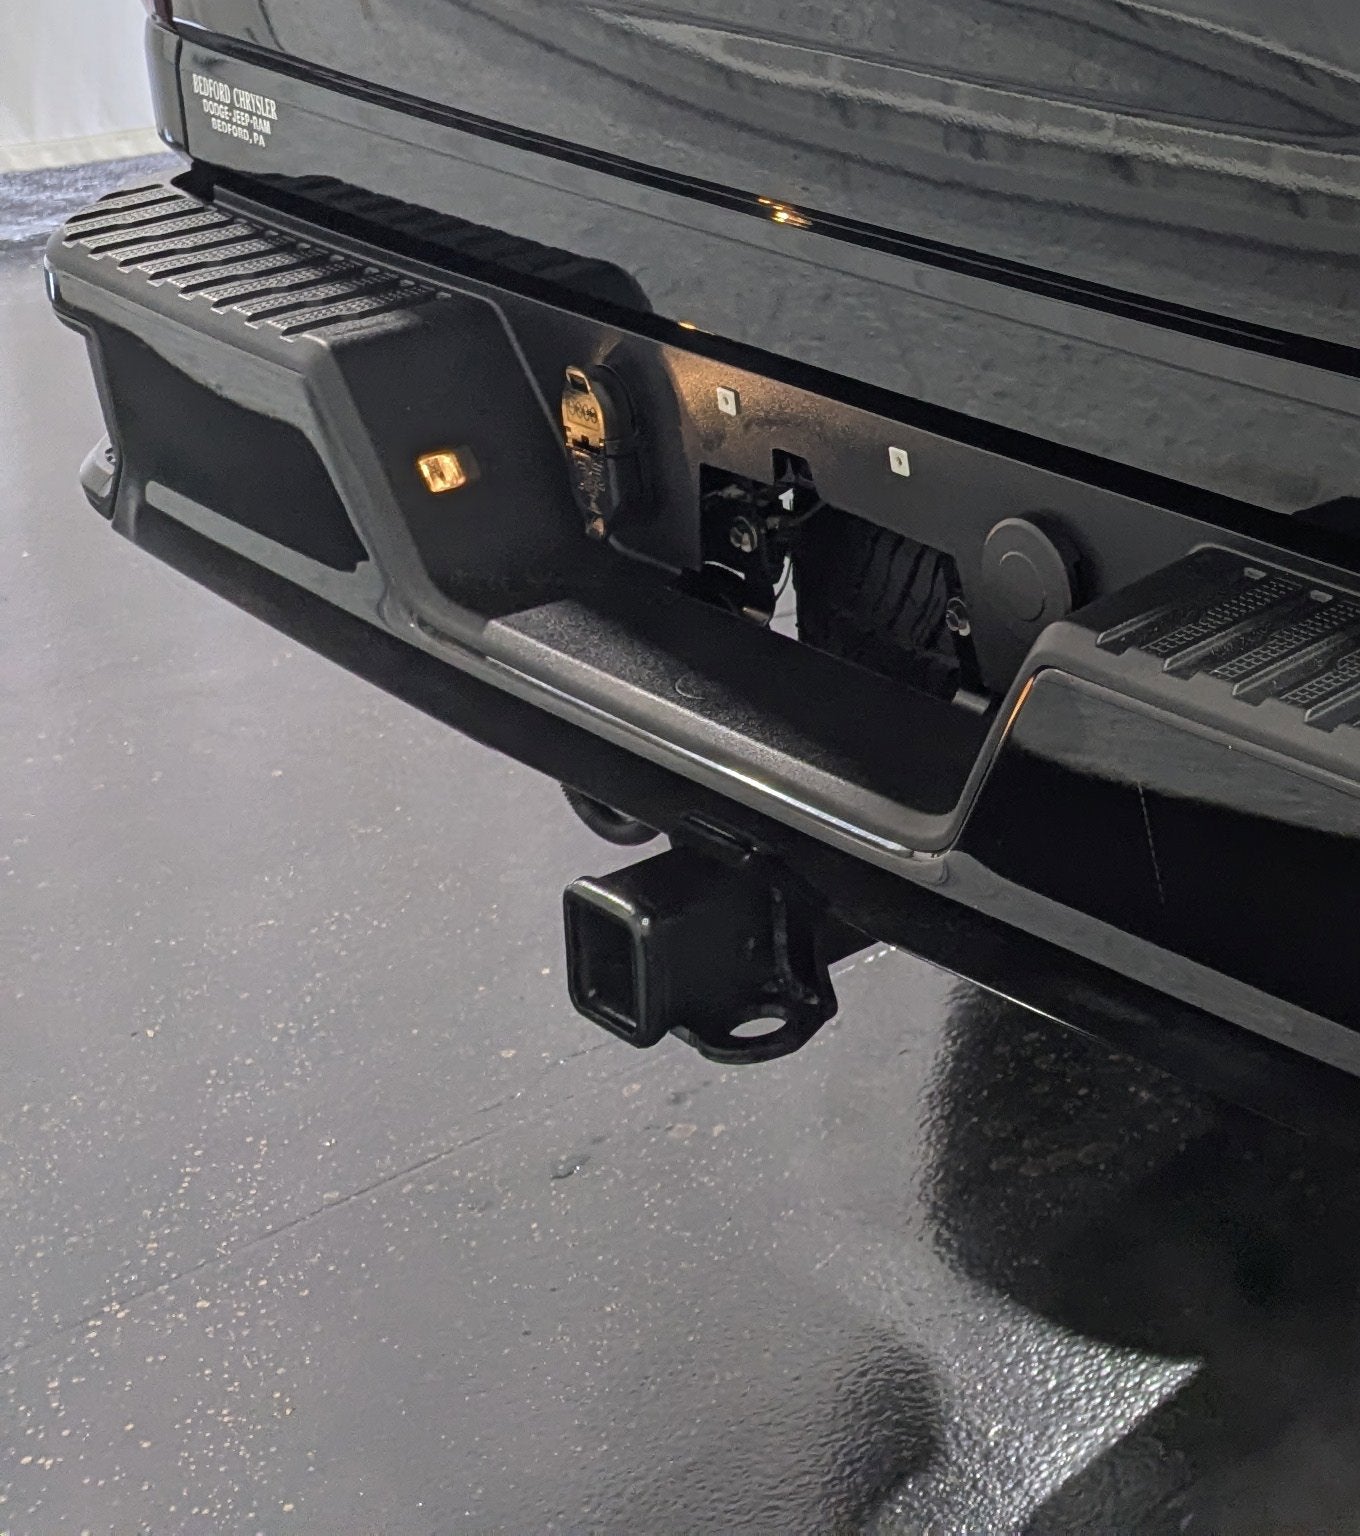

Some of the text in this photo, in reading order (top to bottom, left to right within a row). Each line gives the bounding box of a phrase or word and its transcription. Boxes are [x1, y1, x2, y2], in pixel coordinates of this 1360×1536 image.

[192, 73, 278, 120] BEDFORD CHRYSLER
[211, 117, 266, 148] BEDFORD, PA
